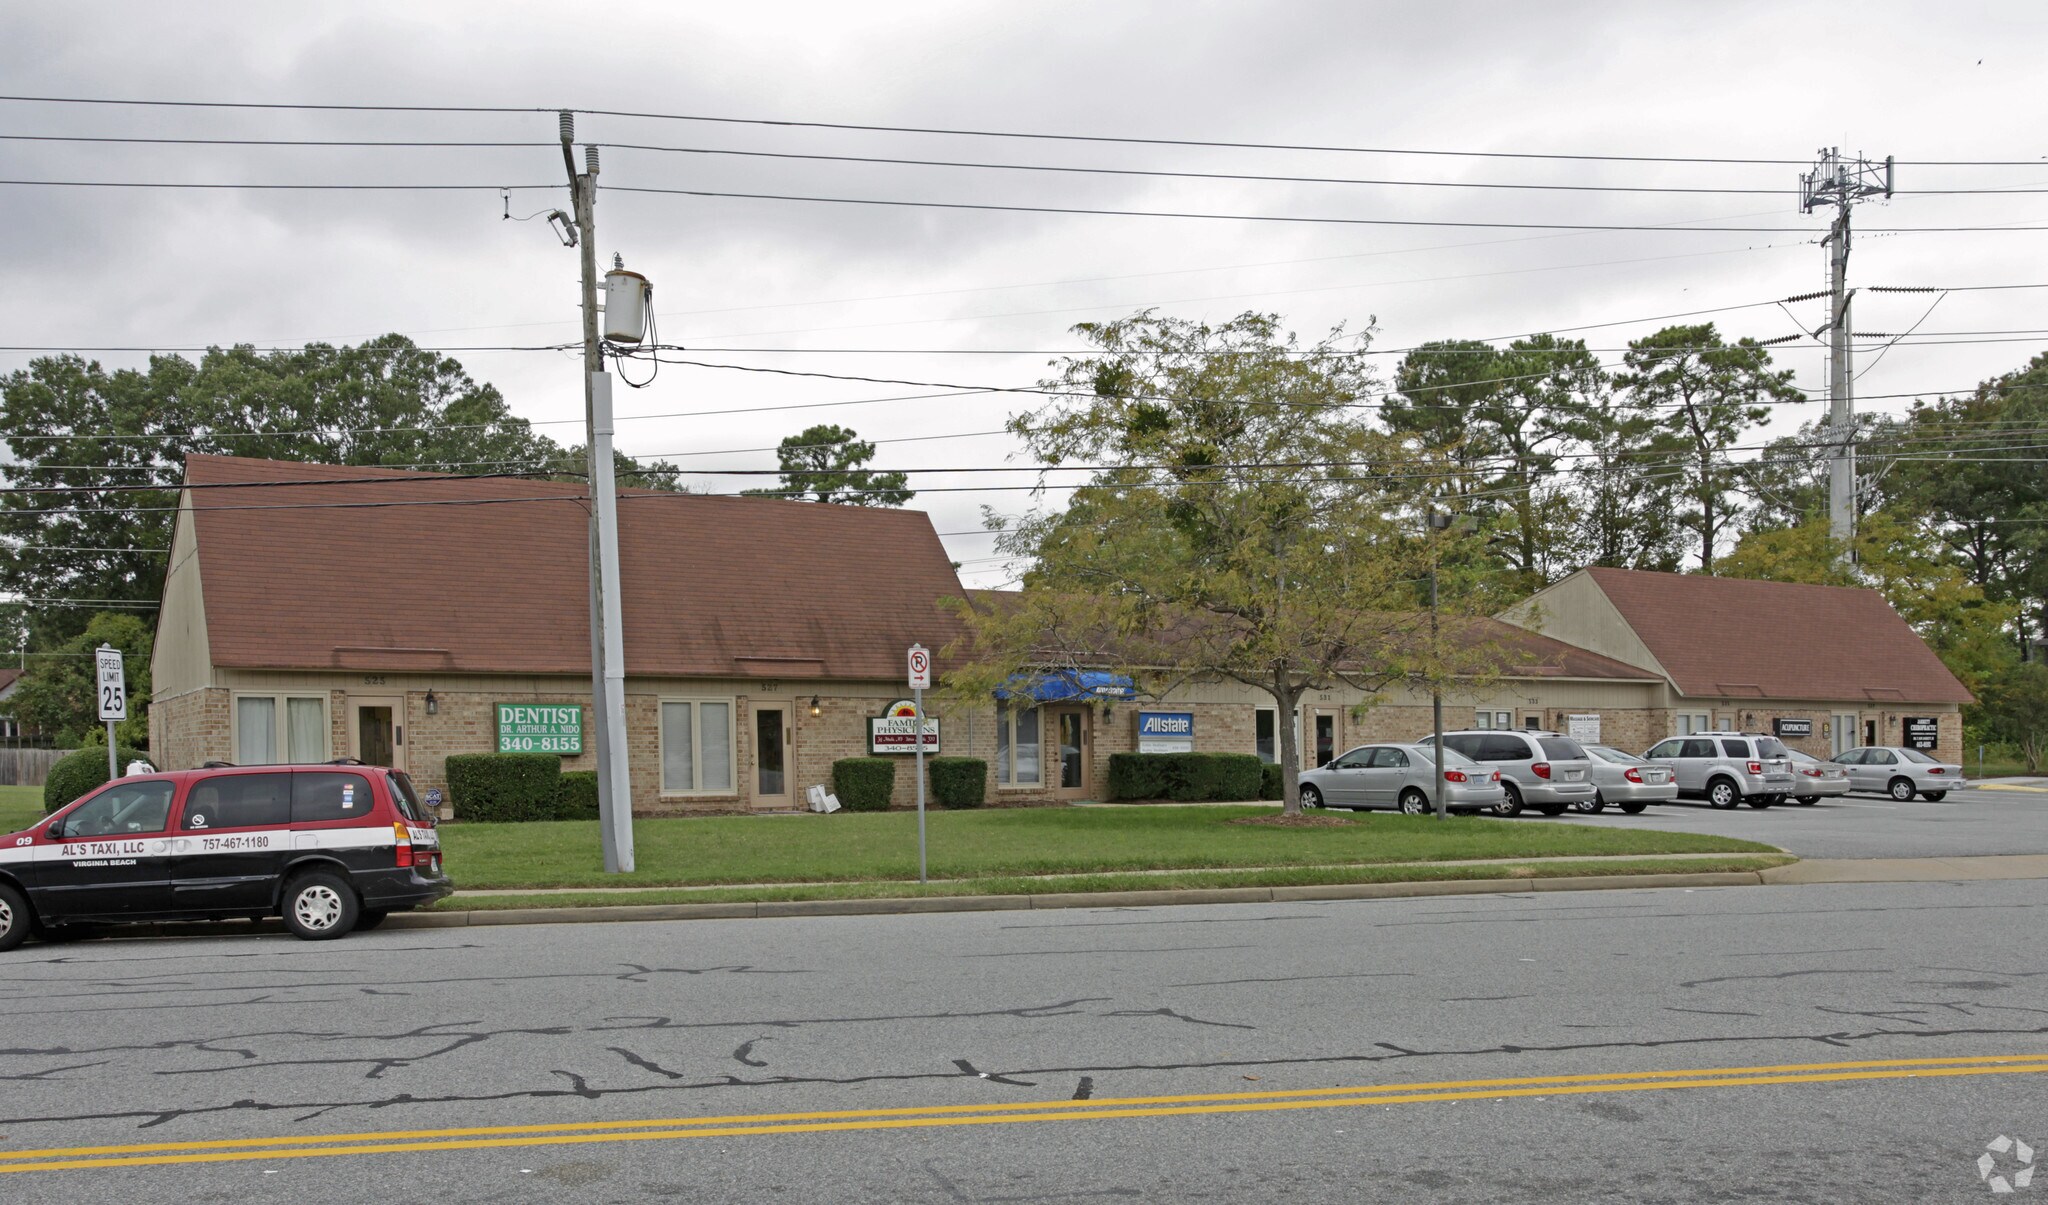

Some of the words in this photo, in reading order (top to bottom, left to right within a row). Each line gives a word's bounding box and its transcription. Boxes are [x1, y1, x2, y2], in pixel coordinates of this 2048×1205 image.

[100, 658, 121, 670] SPEED
[103, 672, 120, 683] LIMIT
[364, 676, 386, 685] 525
[761, 683, 778, 691] 527
[103, 686, 123, 711] 25
[501, 707, 579, 724] DENTIST
[501, 725, 513, 734] DR.
[516, 725, 547, 733] ARTHUR
[561, 725, 580, 734] NIDO
[1143, 717, 1189, 733] Allstate
[1781, 723, 1810, 732] ACUPUNCTURE
[501, 737, 580, 750] 340-8155
[16, 836, 33, 846] 09
[203, 836, 269, 850] 757-467-1180
[61, 844, 87, 856] AL'S
[90, 842, 120, 856] TAXI,
[124, 842, 145, 854] LLC
[73, 860, 109, 868] VIRGINIA
